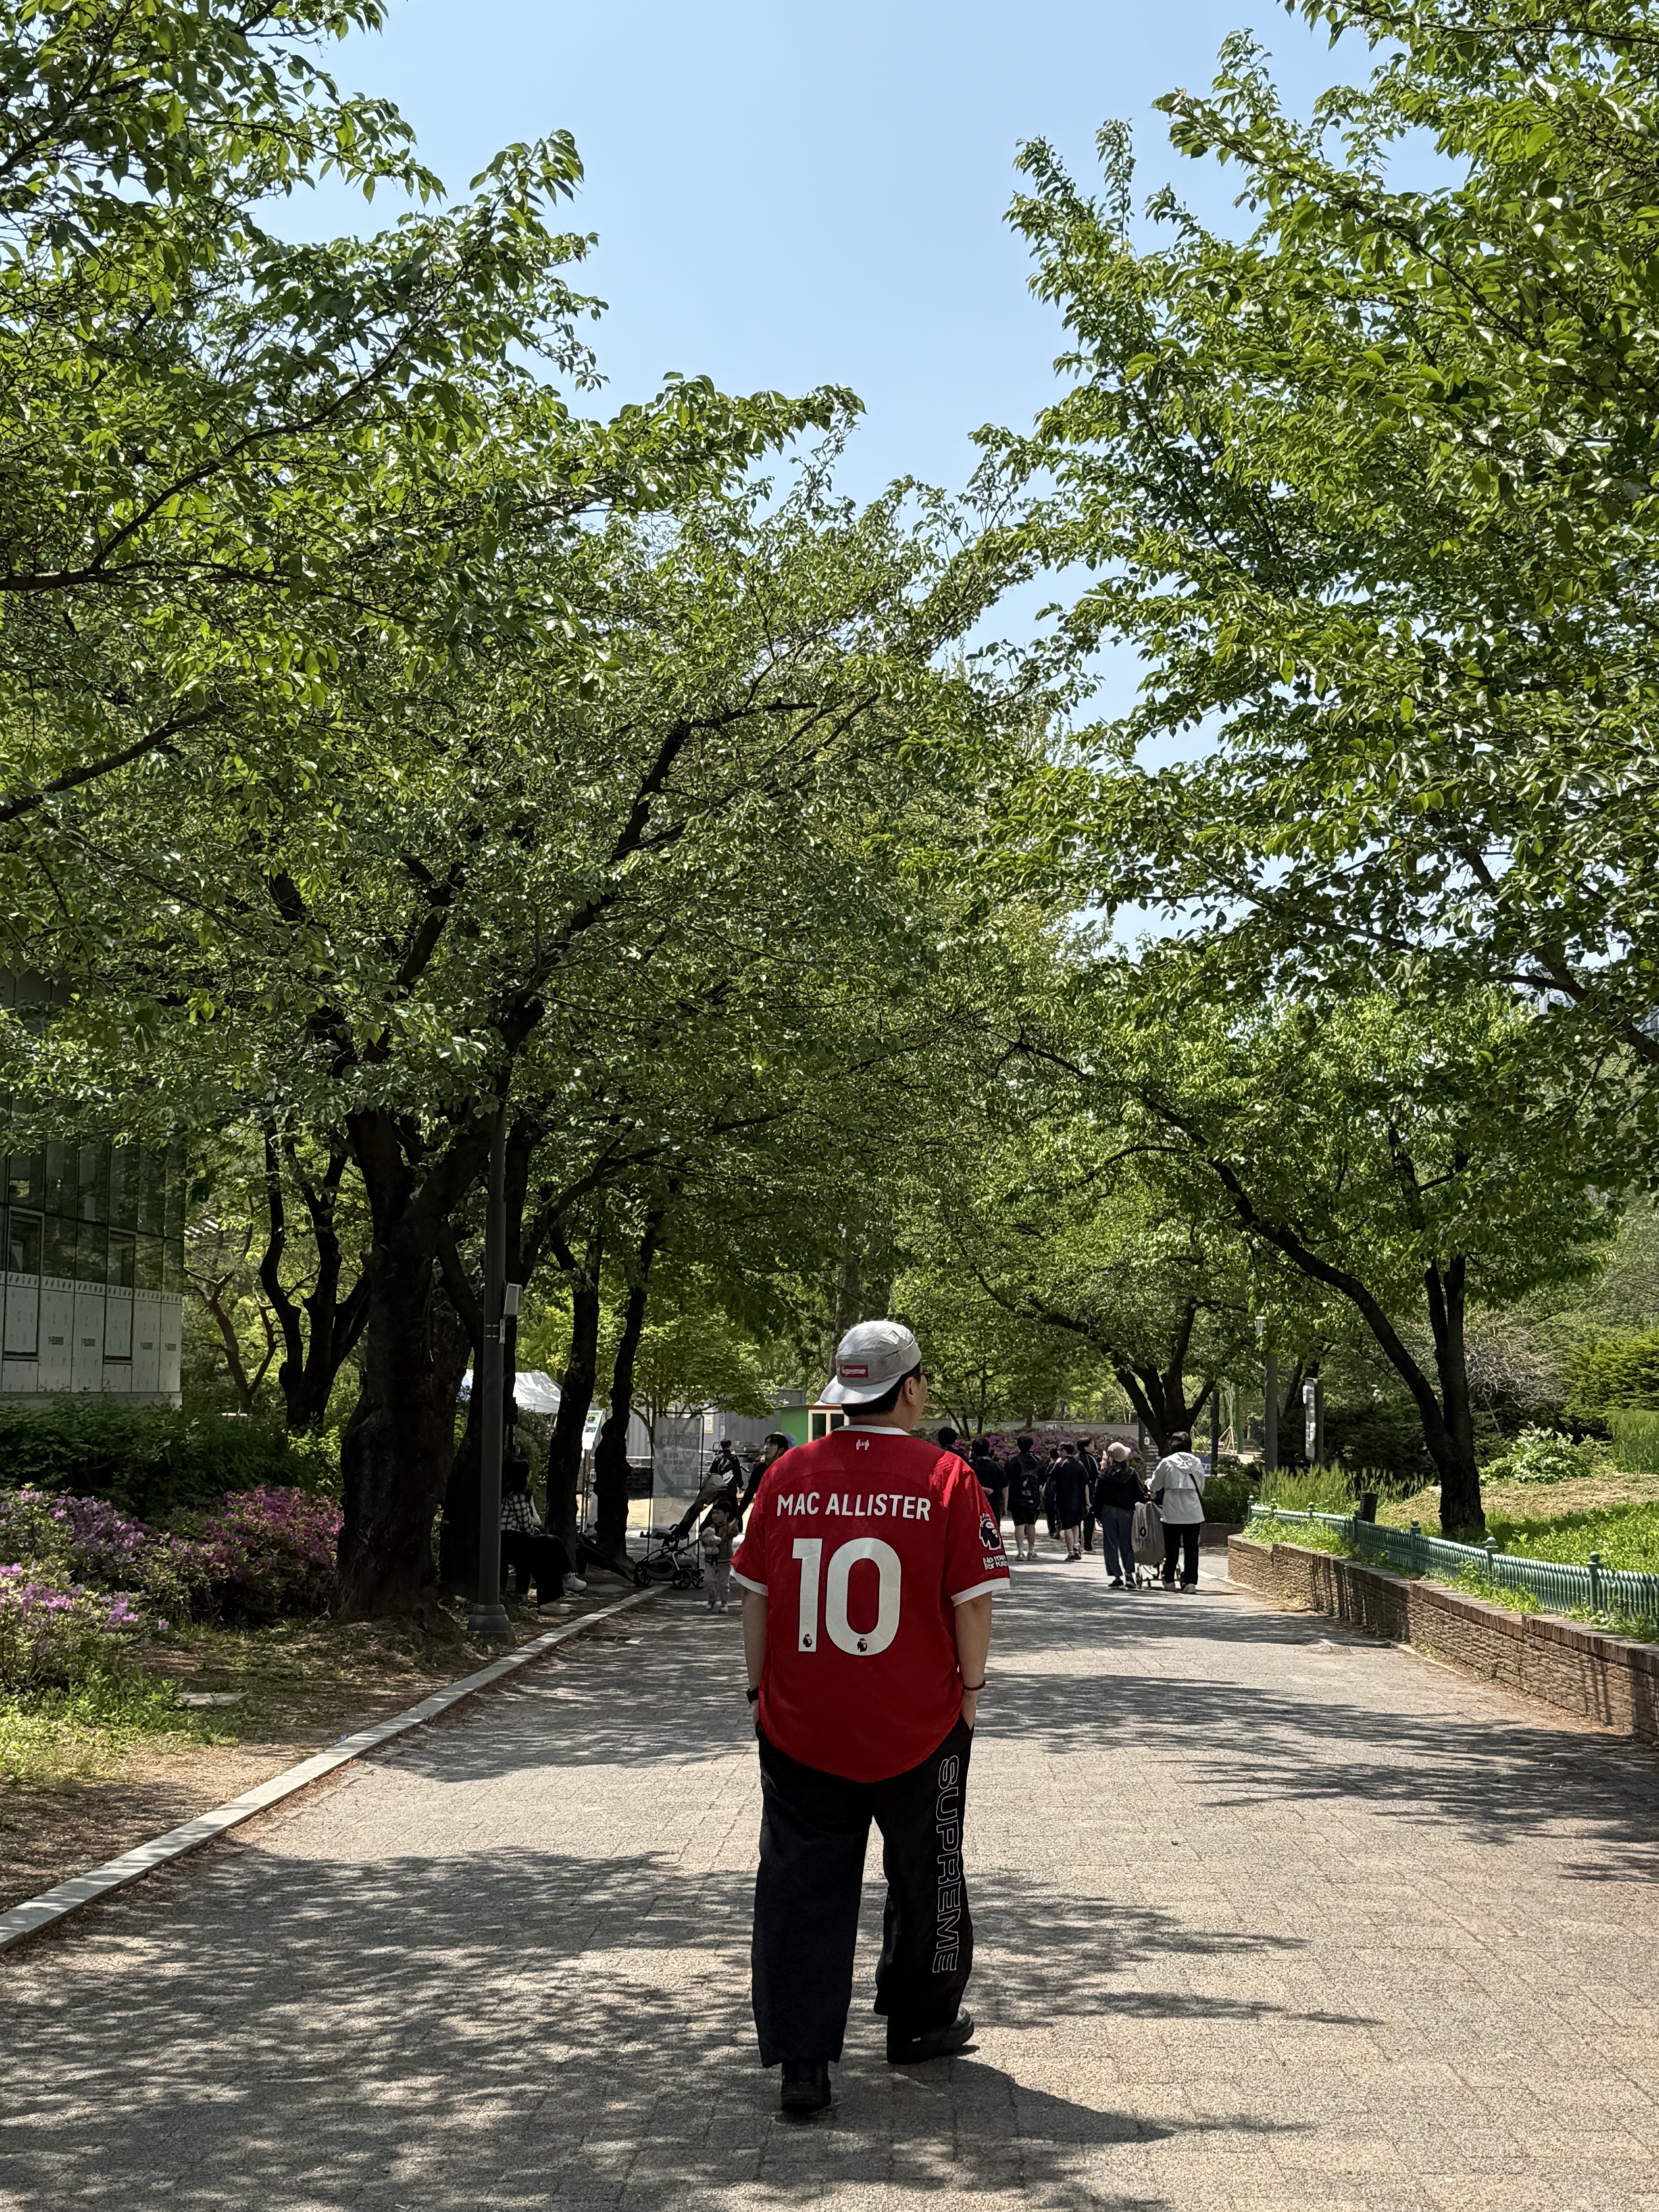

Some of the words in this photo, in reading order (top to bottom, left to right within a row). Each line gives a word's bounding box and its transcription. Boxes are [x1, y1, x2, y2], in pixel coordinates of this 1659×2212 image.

[777, 1492, 820, 1516] MAC
[825, 1493, 931, 1521] ALLISTER
[792, 1537, 901, 1656] 10
[932, 1755, 961, 1973] SUPREME
